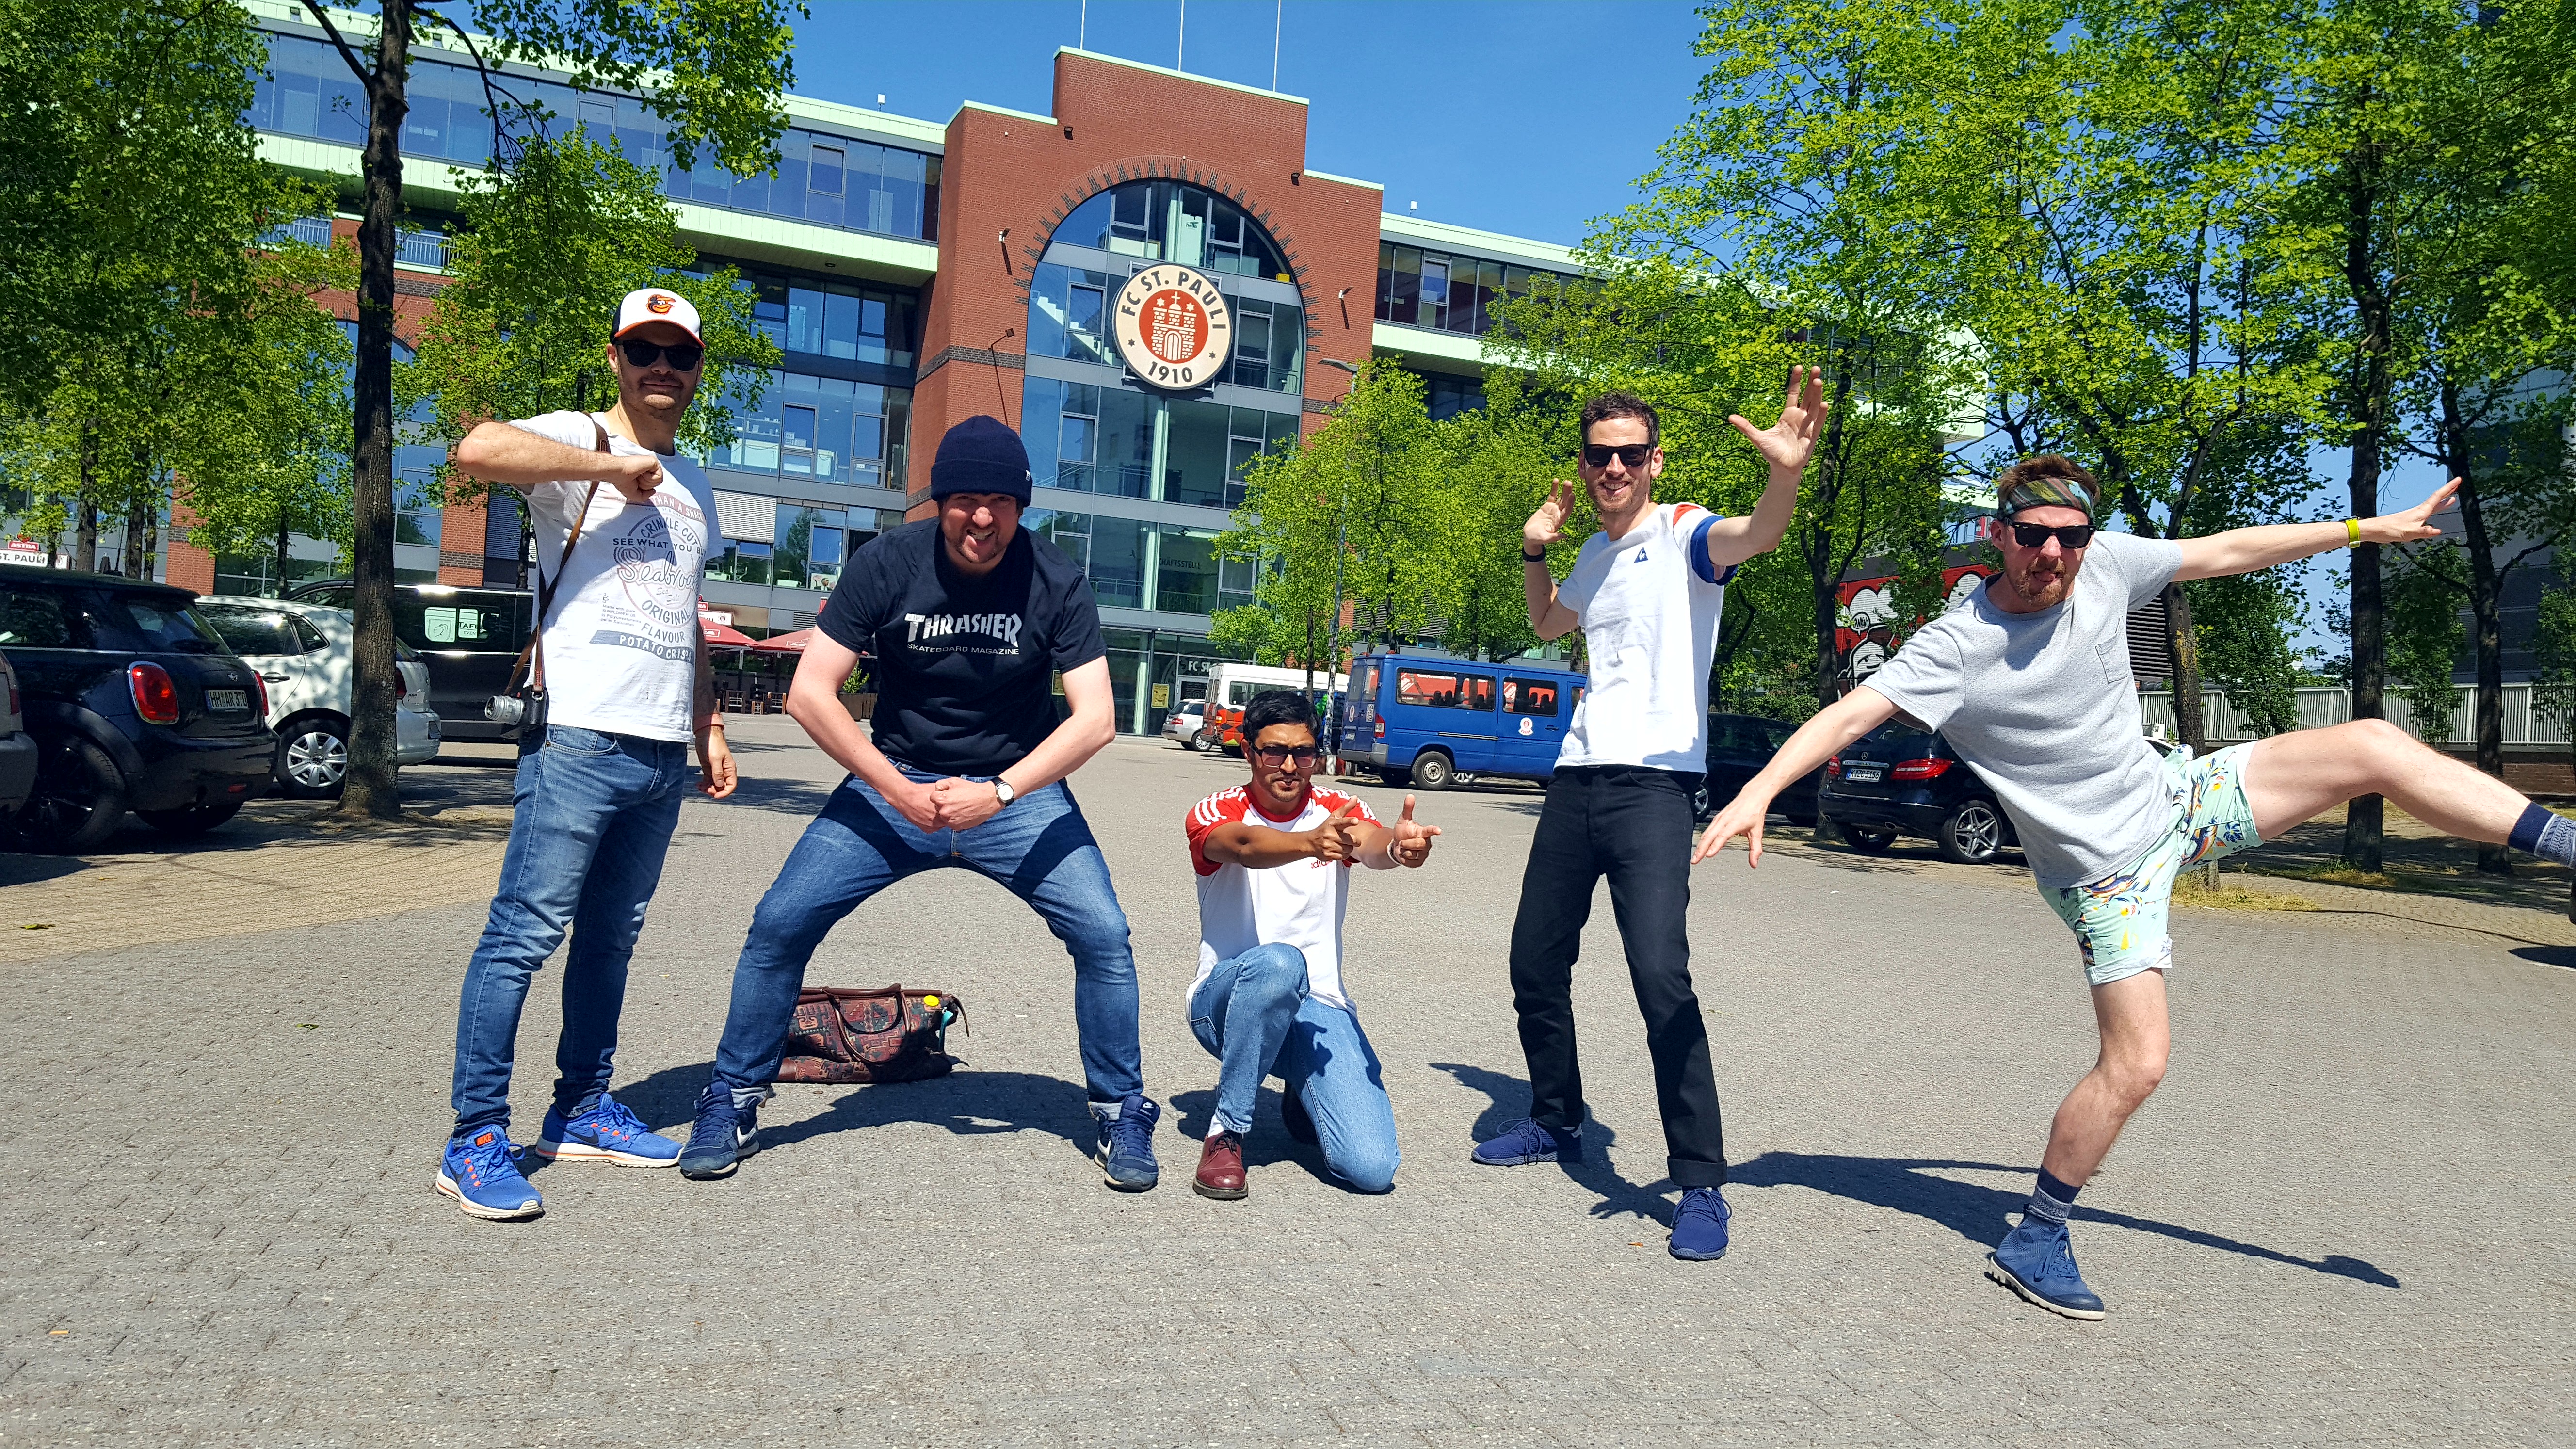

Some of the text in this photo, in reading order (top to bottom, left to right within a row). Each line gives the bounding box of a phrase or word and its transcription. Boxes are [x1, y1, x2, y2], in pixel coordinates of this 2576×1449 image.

[1121, 270, 1226, 329] FC ST. PAULI
[1148, 361, 1193, 384] 1910
[654, 495, 674, 507] THAN
[677, 503, 683, 513] A
[640, 517, 698, 546] CRINKLE CUT
[636, 538, 669, 549] WHAT
[673, 543, 692, 552] YOU
[15, 554, 45, 564] PAULI
[642, 600, 690, 625] ORIGINAL
[641, 623, 685, 643] FLAVOUR
[904, 613, 1022, 648] THRASHER
[619, 634, 692, 661] POTATO CRISPS
[907, 643, 968, 653] SKATEBOARD
[1188, 660, 1198, 672] FC
[477, 1133, 492, 1146] NIKE
